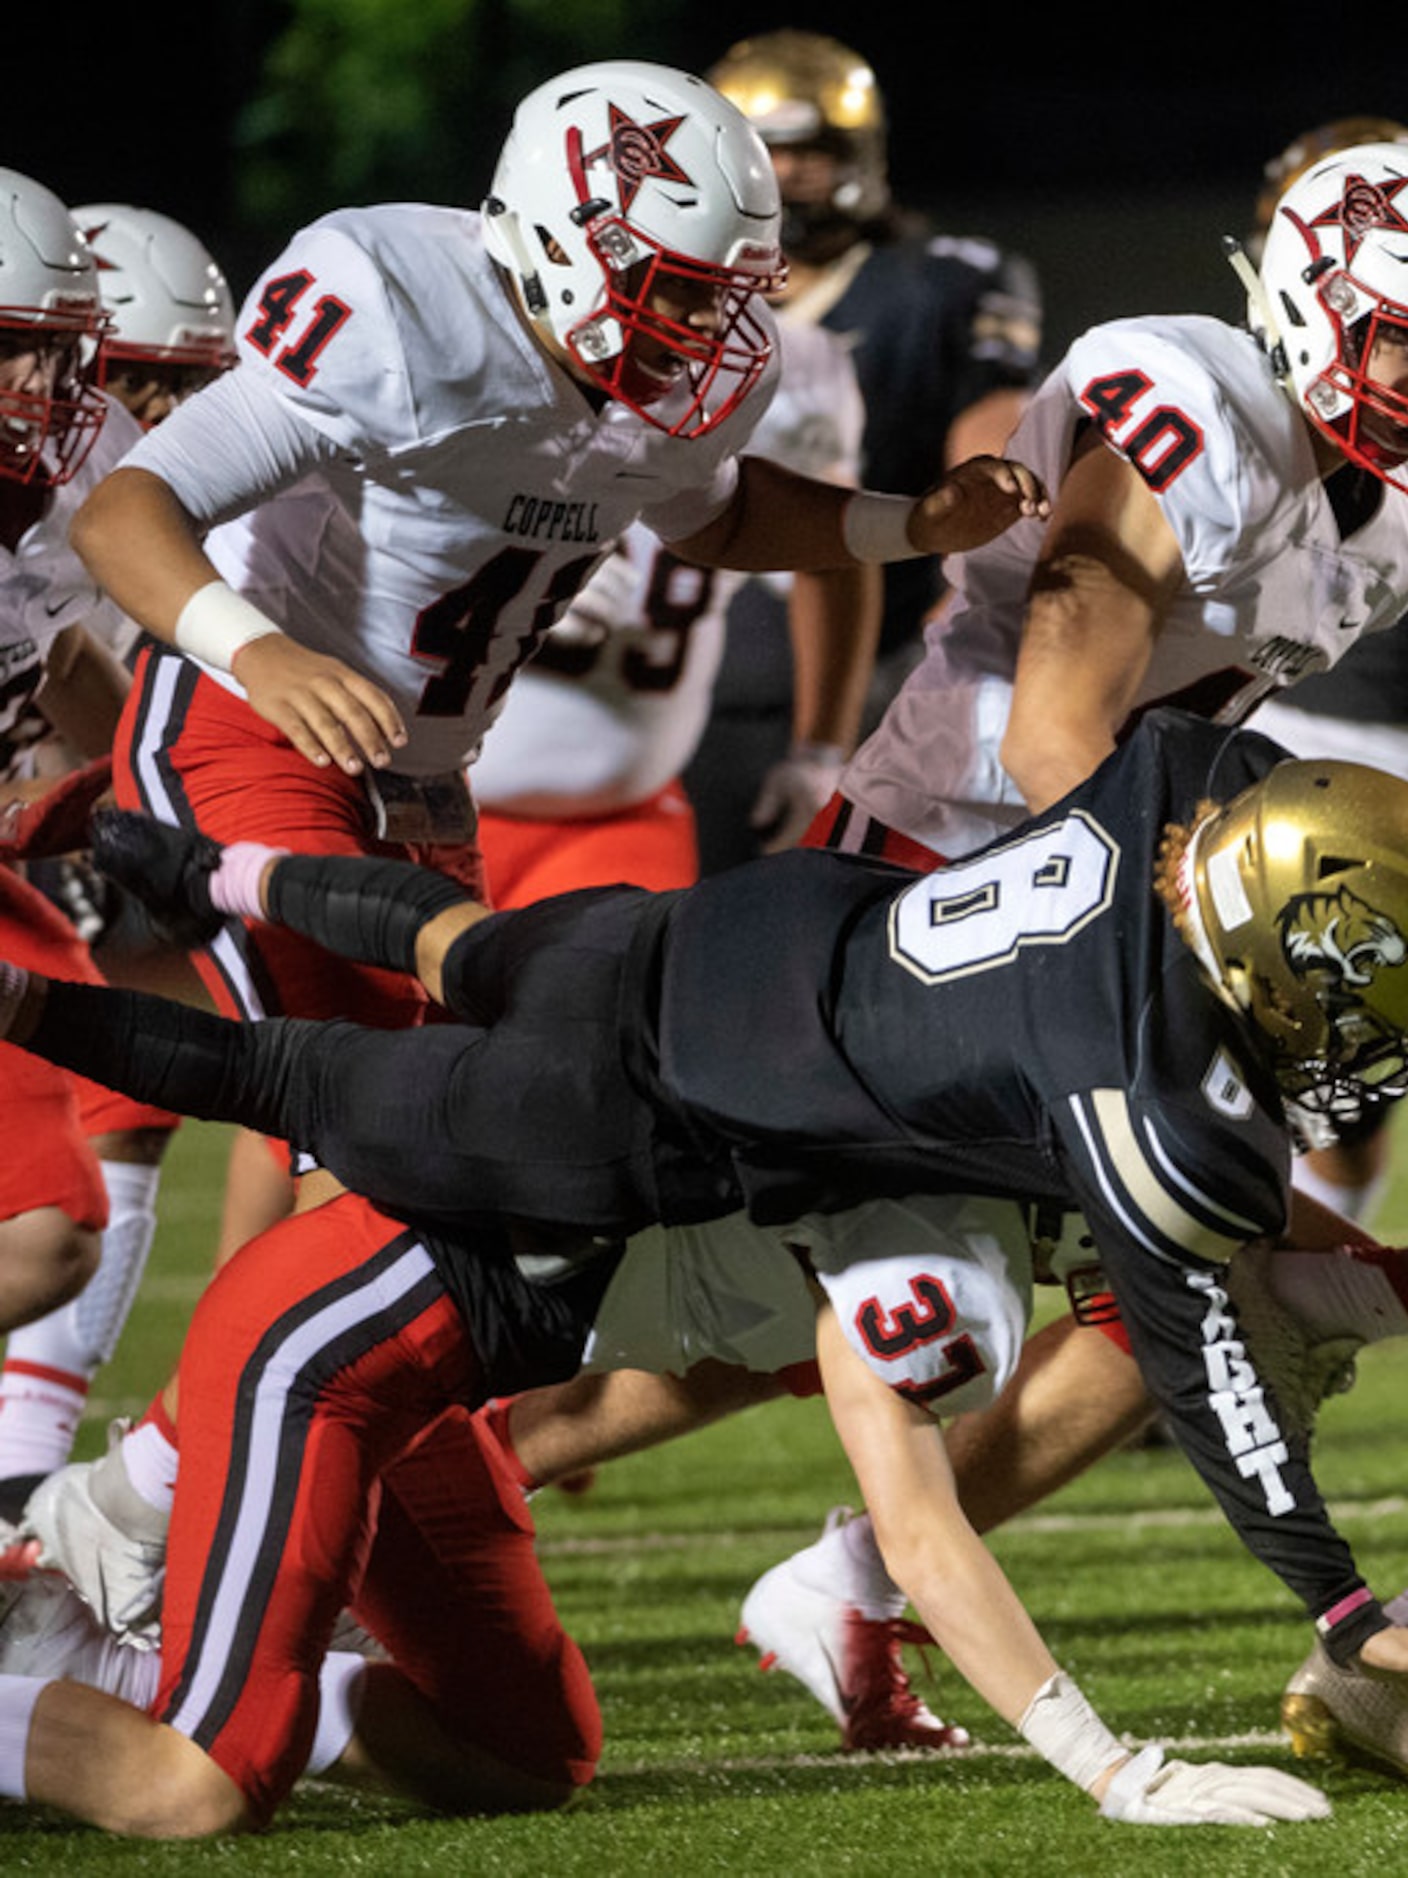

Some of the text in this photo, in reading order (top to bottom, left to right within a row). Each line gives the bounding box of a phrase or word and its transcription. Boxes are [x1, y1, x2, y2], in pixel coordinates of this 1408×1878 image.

[243, 266, 354, 390] 41
[1079, 367, 1205, 495] 40
[502, 494, 600, 544] COPPELL
[887, 806, 1121, 986] 8
[853, 1270, 987, 1410] 37
